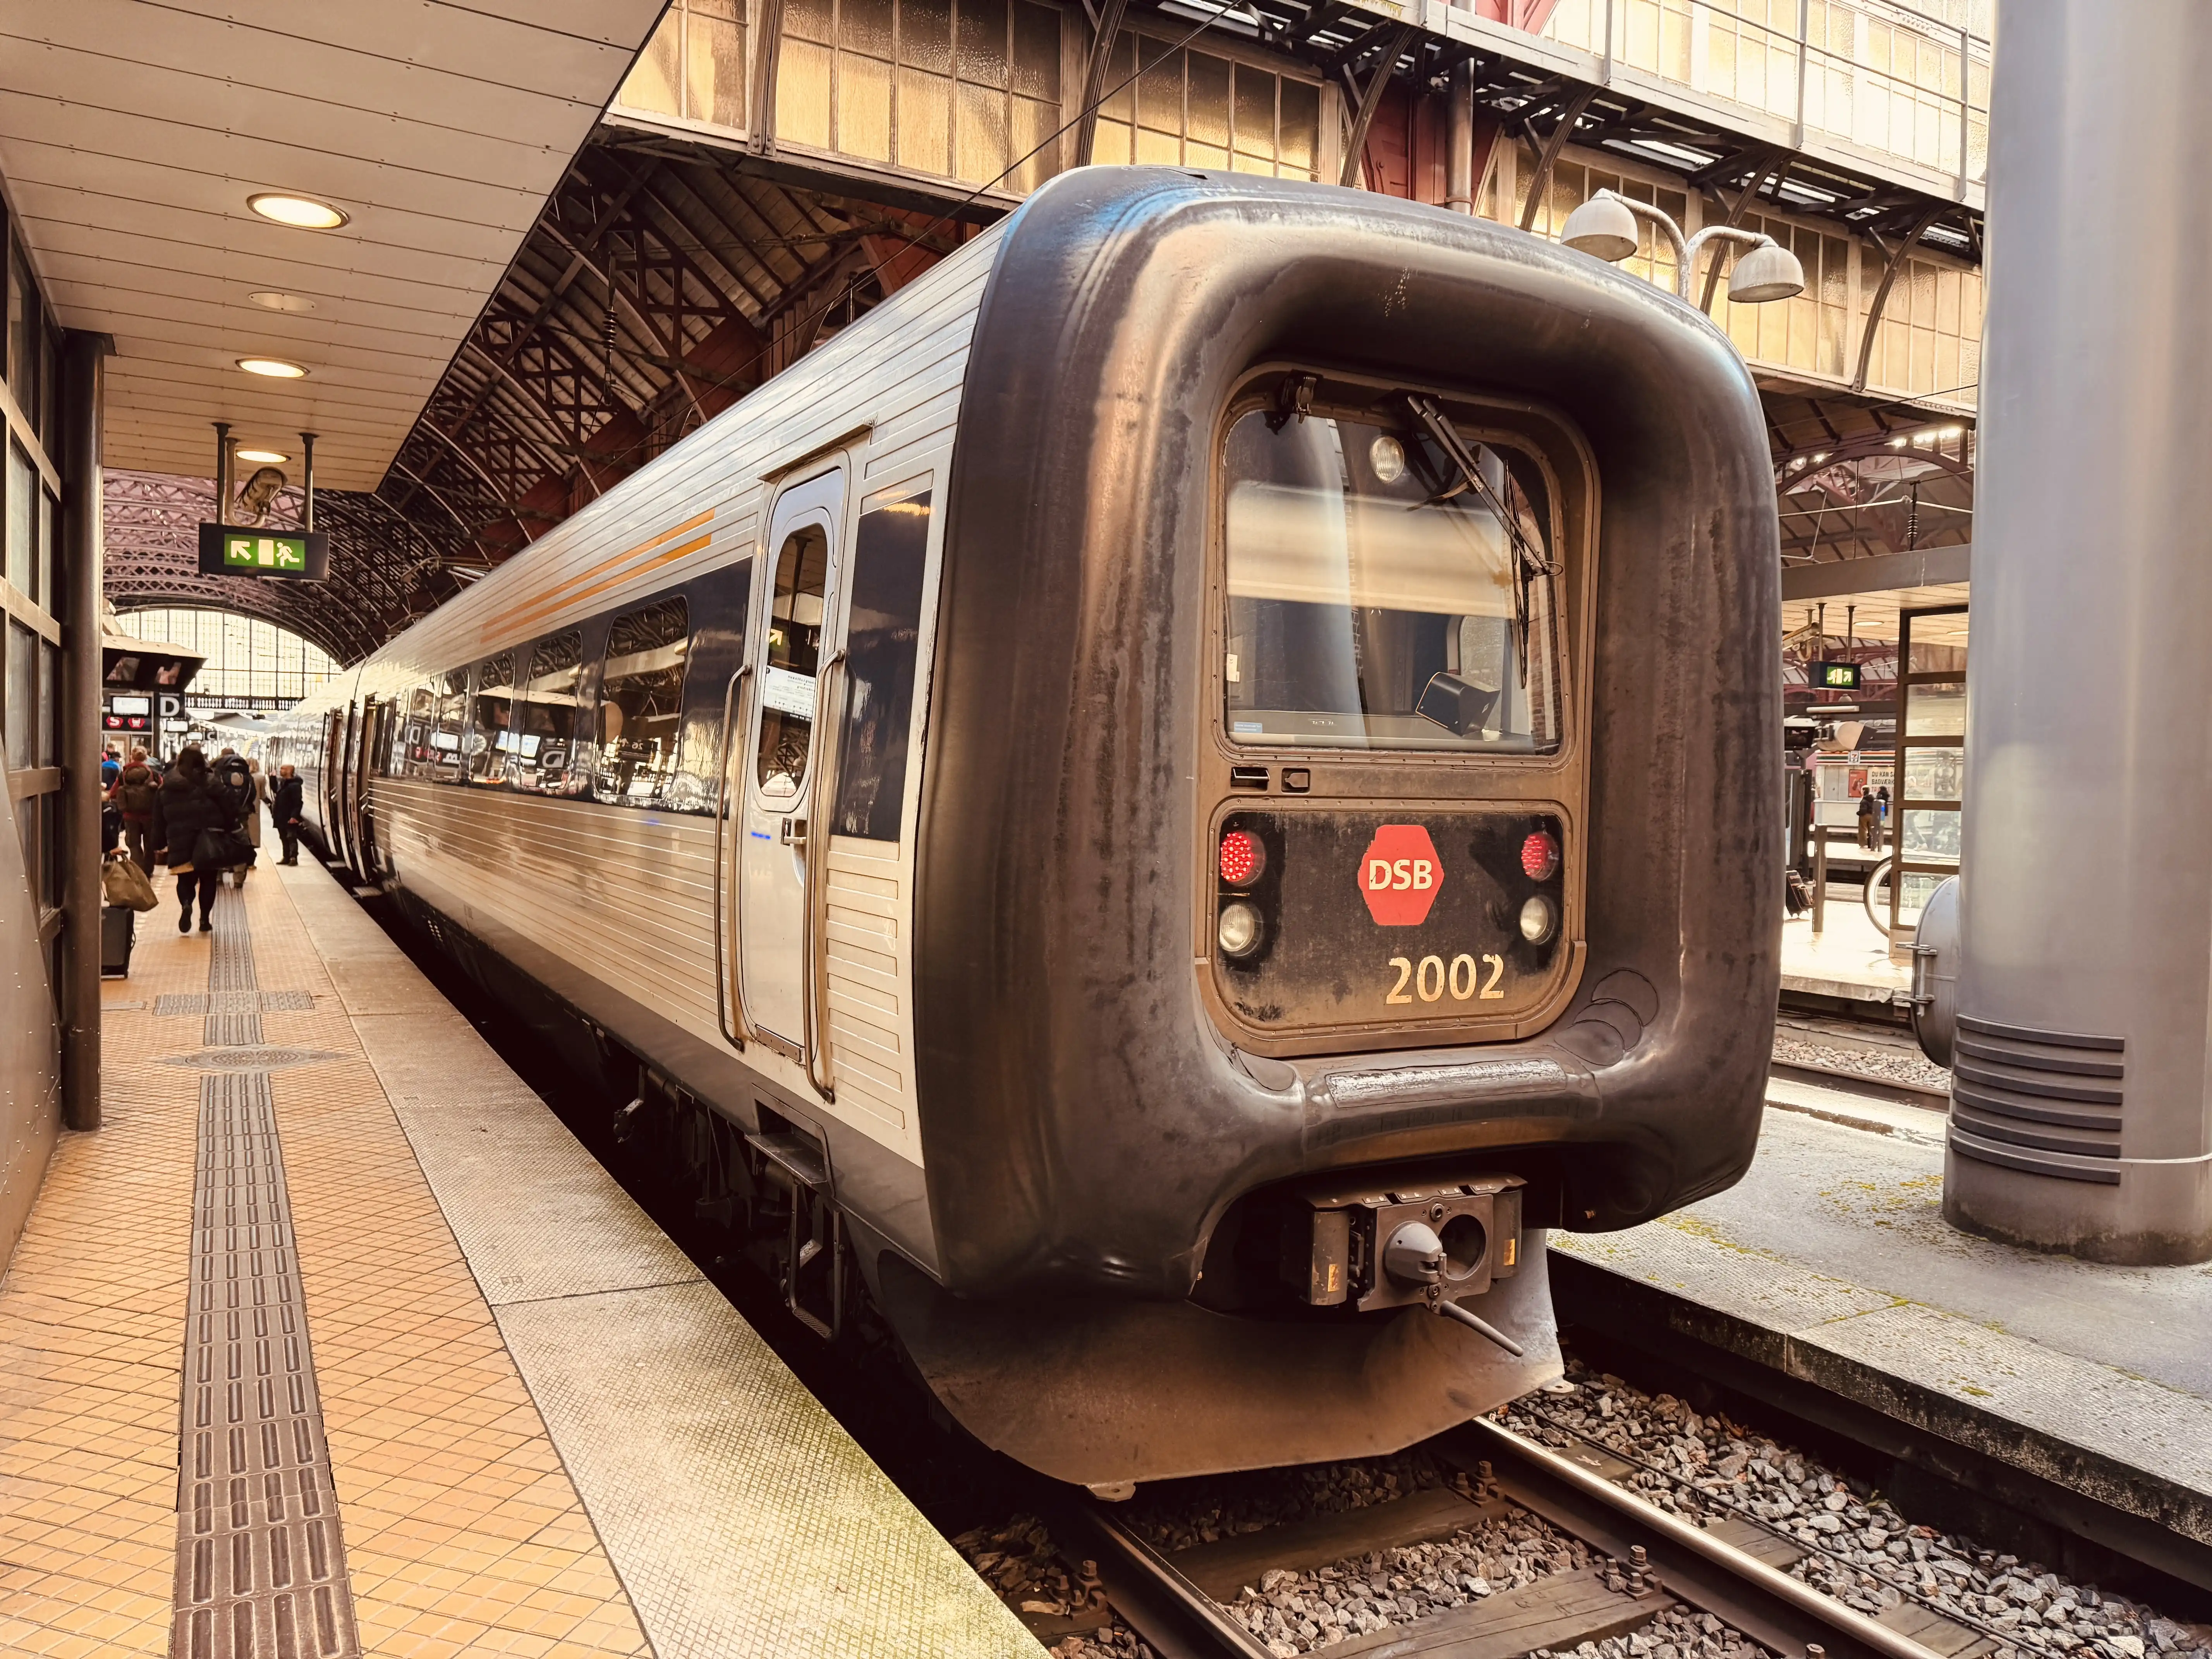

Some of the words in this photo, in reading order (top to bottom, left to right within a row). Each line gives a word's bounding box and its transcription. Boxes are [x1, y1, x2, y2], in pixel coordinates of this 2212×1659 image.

[160, 696, 180, 717] D
[109, 716, 120, 726] S
[1368, 859, 1433, 890] DSB
[1385, 953, 1505, 1005] 2002
